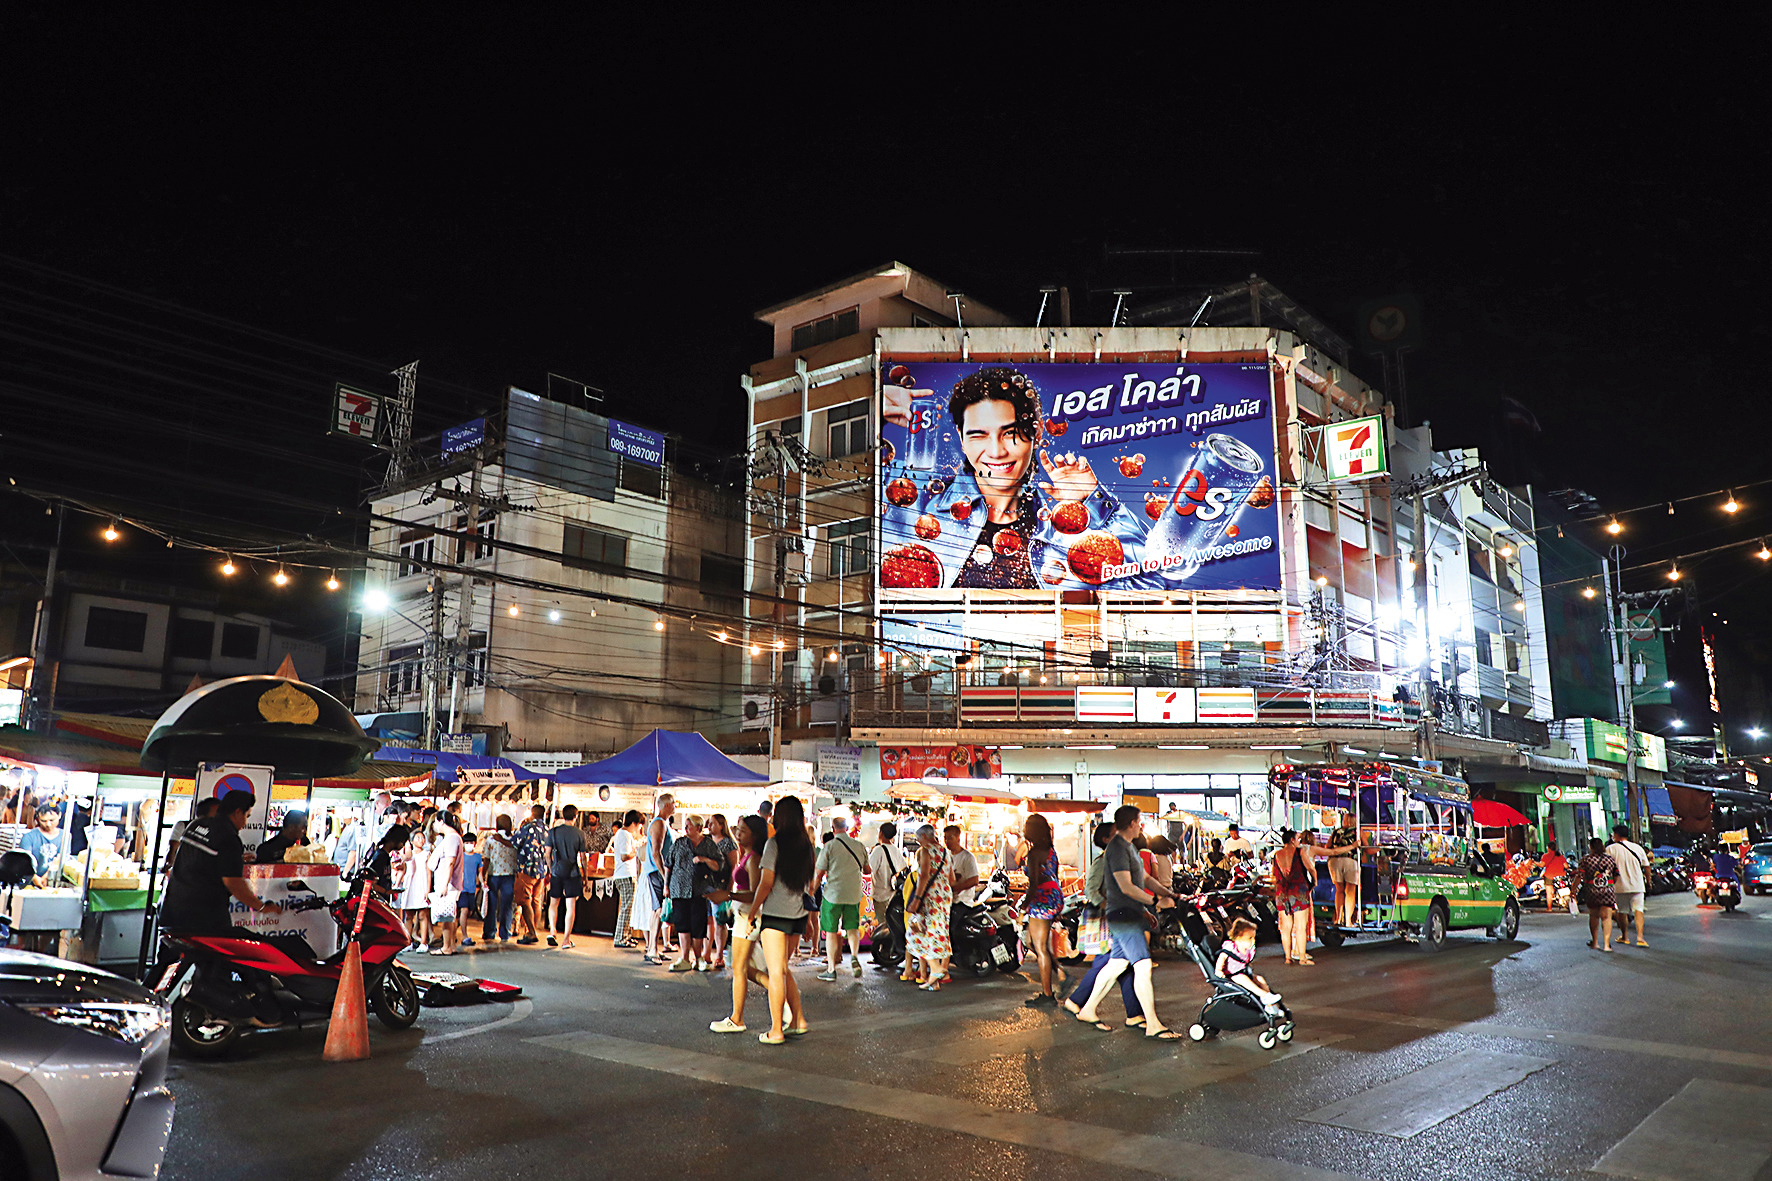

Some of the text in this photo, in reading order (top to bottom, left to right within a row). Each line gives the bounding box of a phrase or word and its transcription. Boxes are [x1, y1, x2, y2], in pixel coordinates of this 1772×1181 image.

[1051, 366, 1201, 417] เอส โคล่า
[1081, 399, 1261, 445] เกิดมาซ่าาา ทุกสัมผัส
[610, 437, 660, 463] 089-1697007
[1337, 425, 1371, 475] 7
[1102, 536, 1272, 579] Born to be Awesome
[1156, 691, 1177, 720] 7
[674, 800, 703, 809] Chicken
